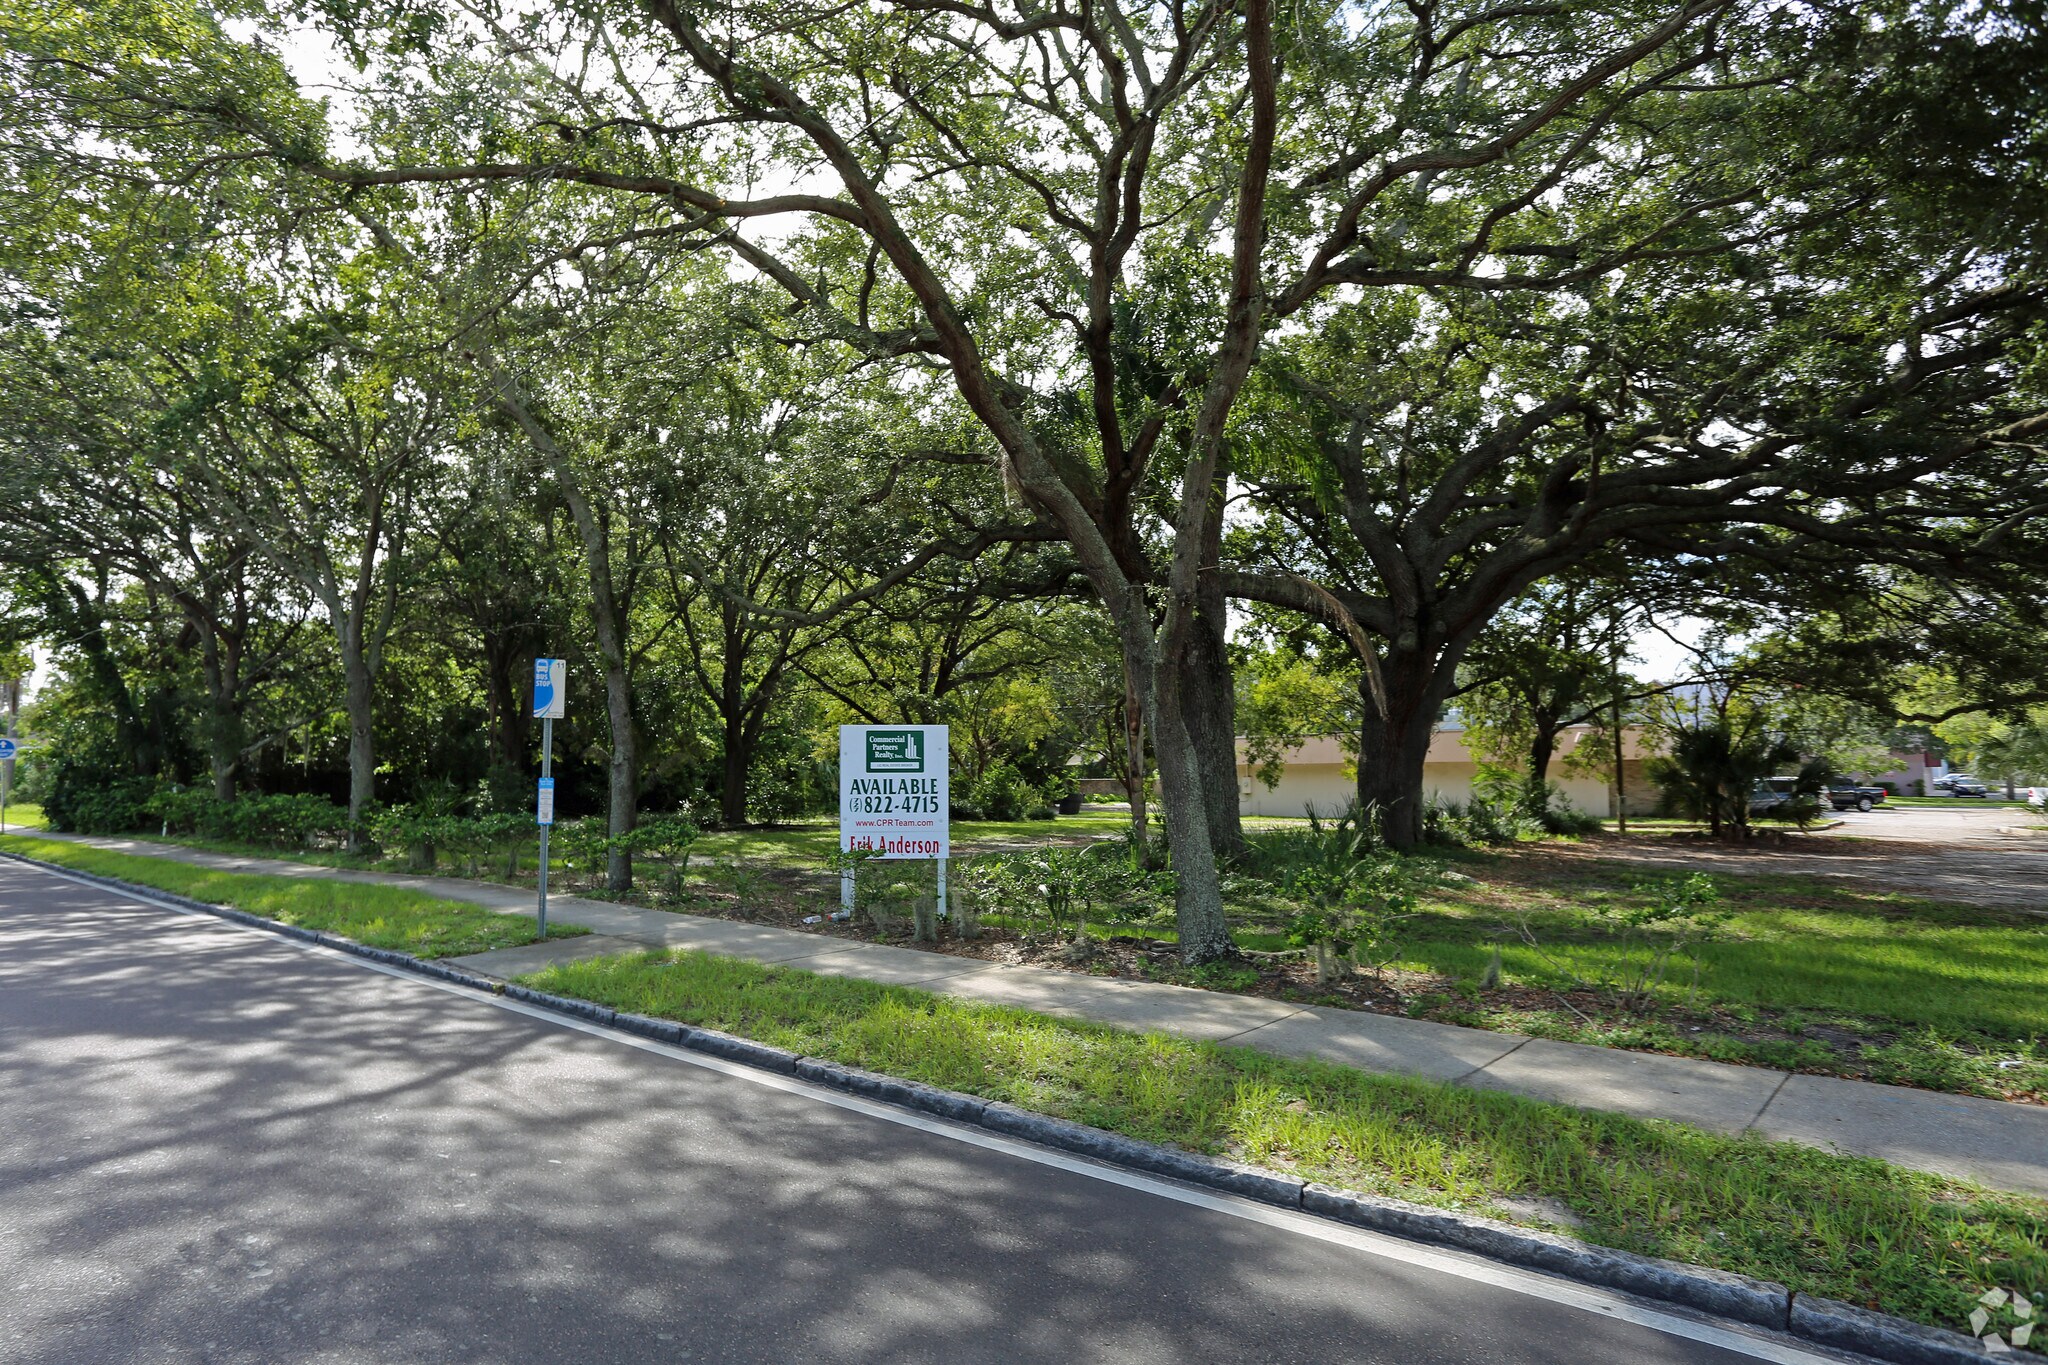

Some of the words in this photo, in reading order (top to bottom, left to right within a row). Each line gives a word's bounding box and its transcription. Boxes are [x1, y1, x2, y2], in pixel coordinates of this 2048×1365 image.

[869, 735, 905, 743] Commercial
[872, 743, 899, 751] Partners
[850, 778, 939, 795] AVAILABLE
[850, 835, 873, 852] Erik
[879, 835, 939, 854] Anderson
